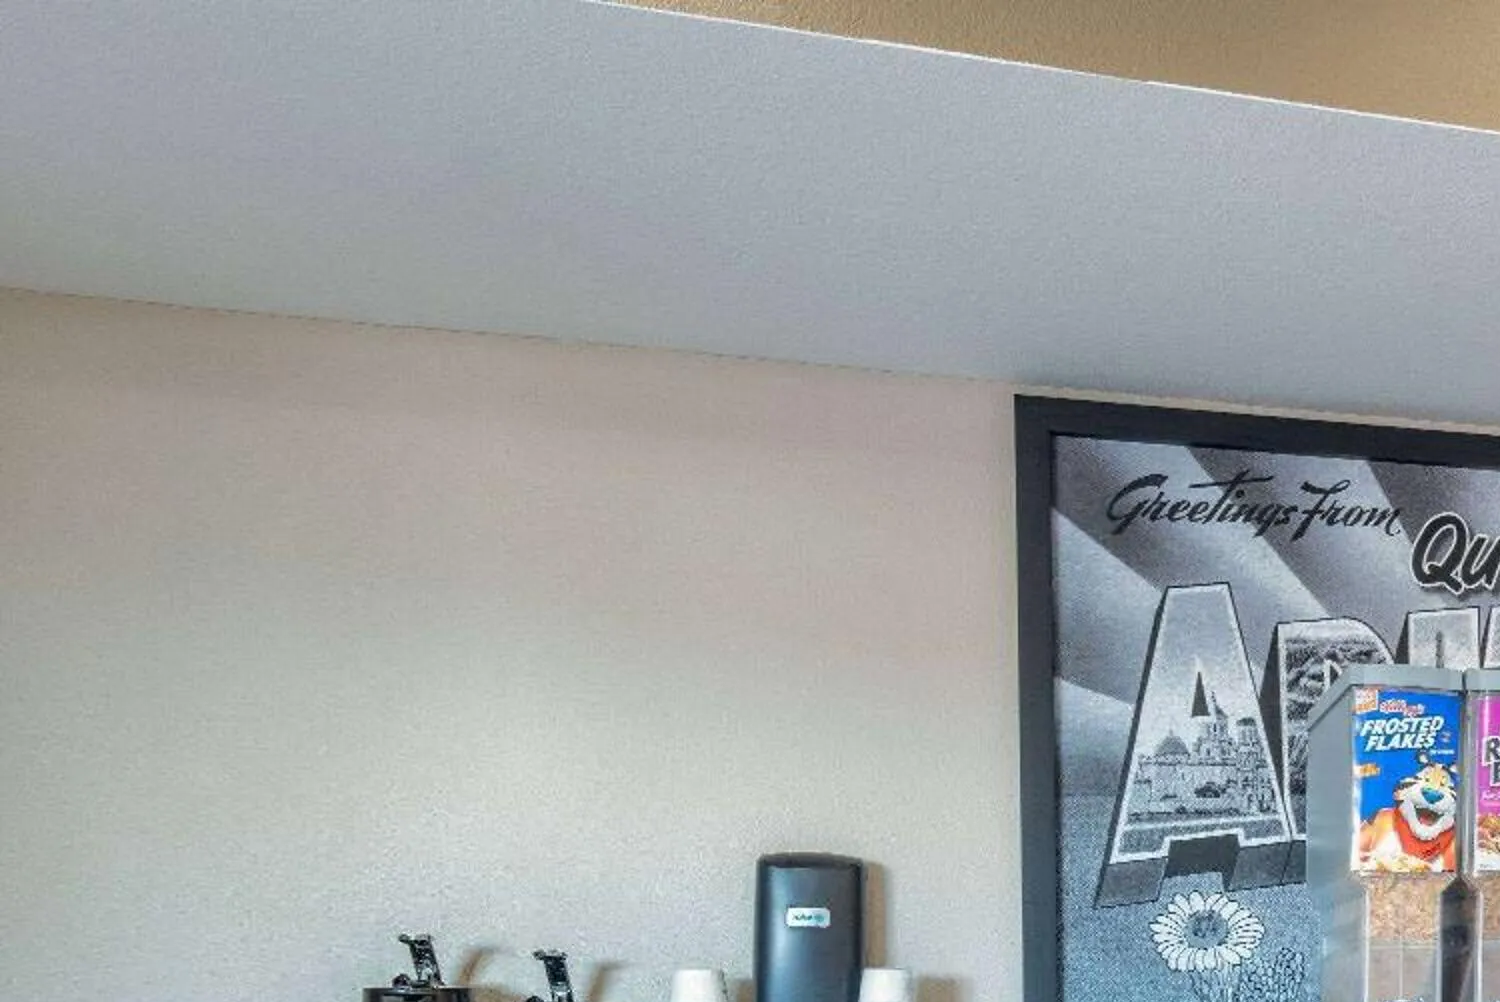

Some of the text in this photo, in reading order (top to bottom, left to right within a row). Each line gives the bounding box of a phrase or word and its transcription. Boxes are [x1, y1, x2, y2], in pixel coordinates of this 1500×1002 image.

[1106, 469, 1402, 542] Greetings From
[1359, 715, 1445, 738] FROSTED
[1364, 731, 1437, 752] FLAKES
